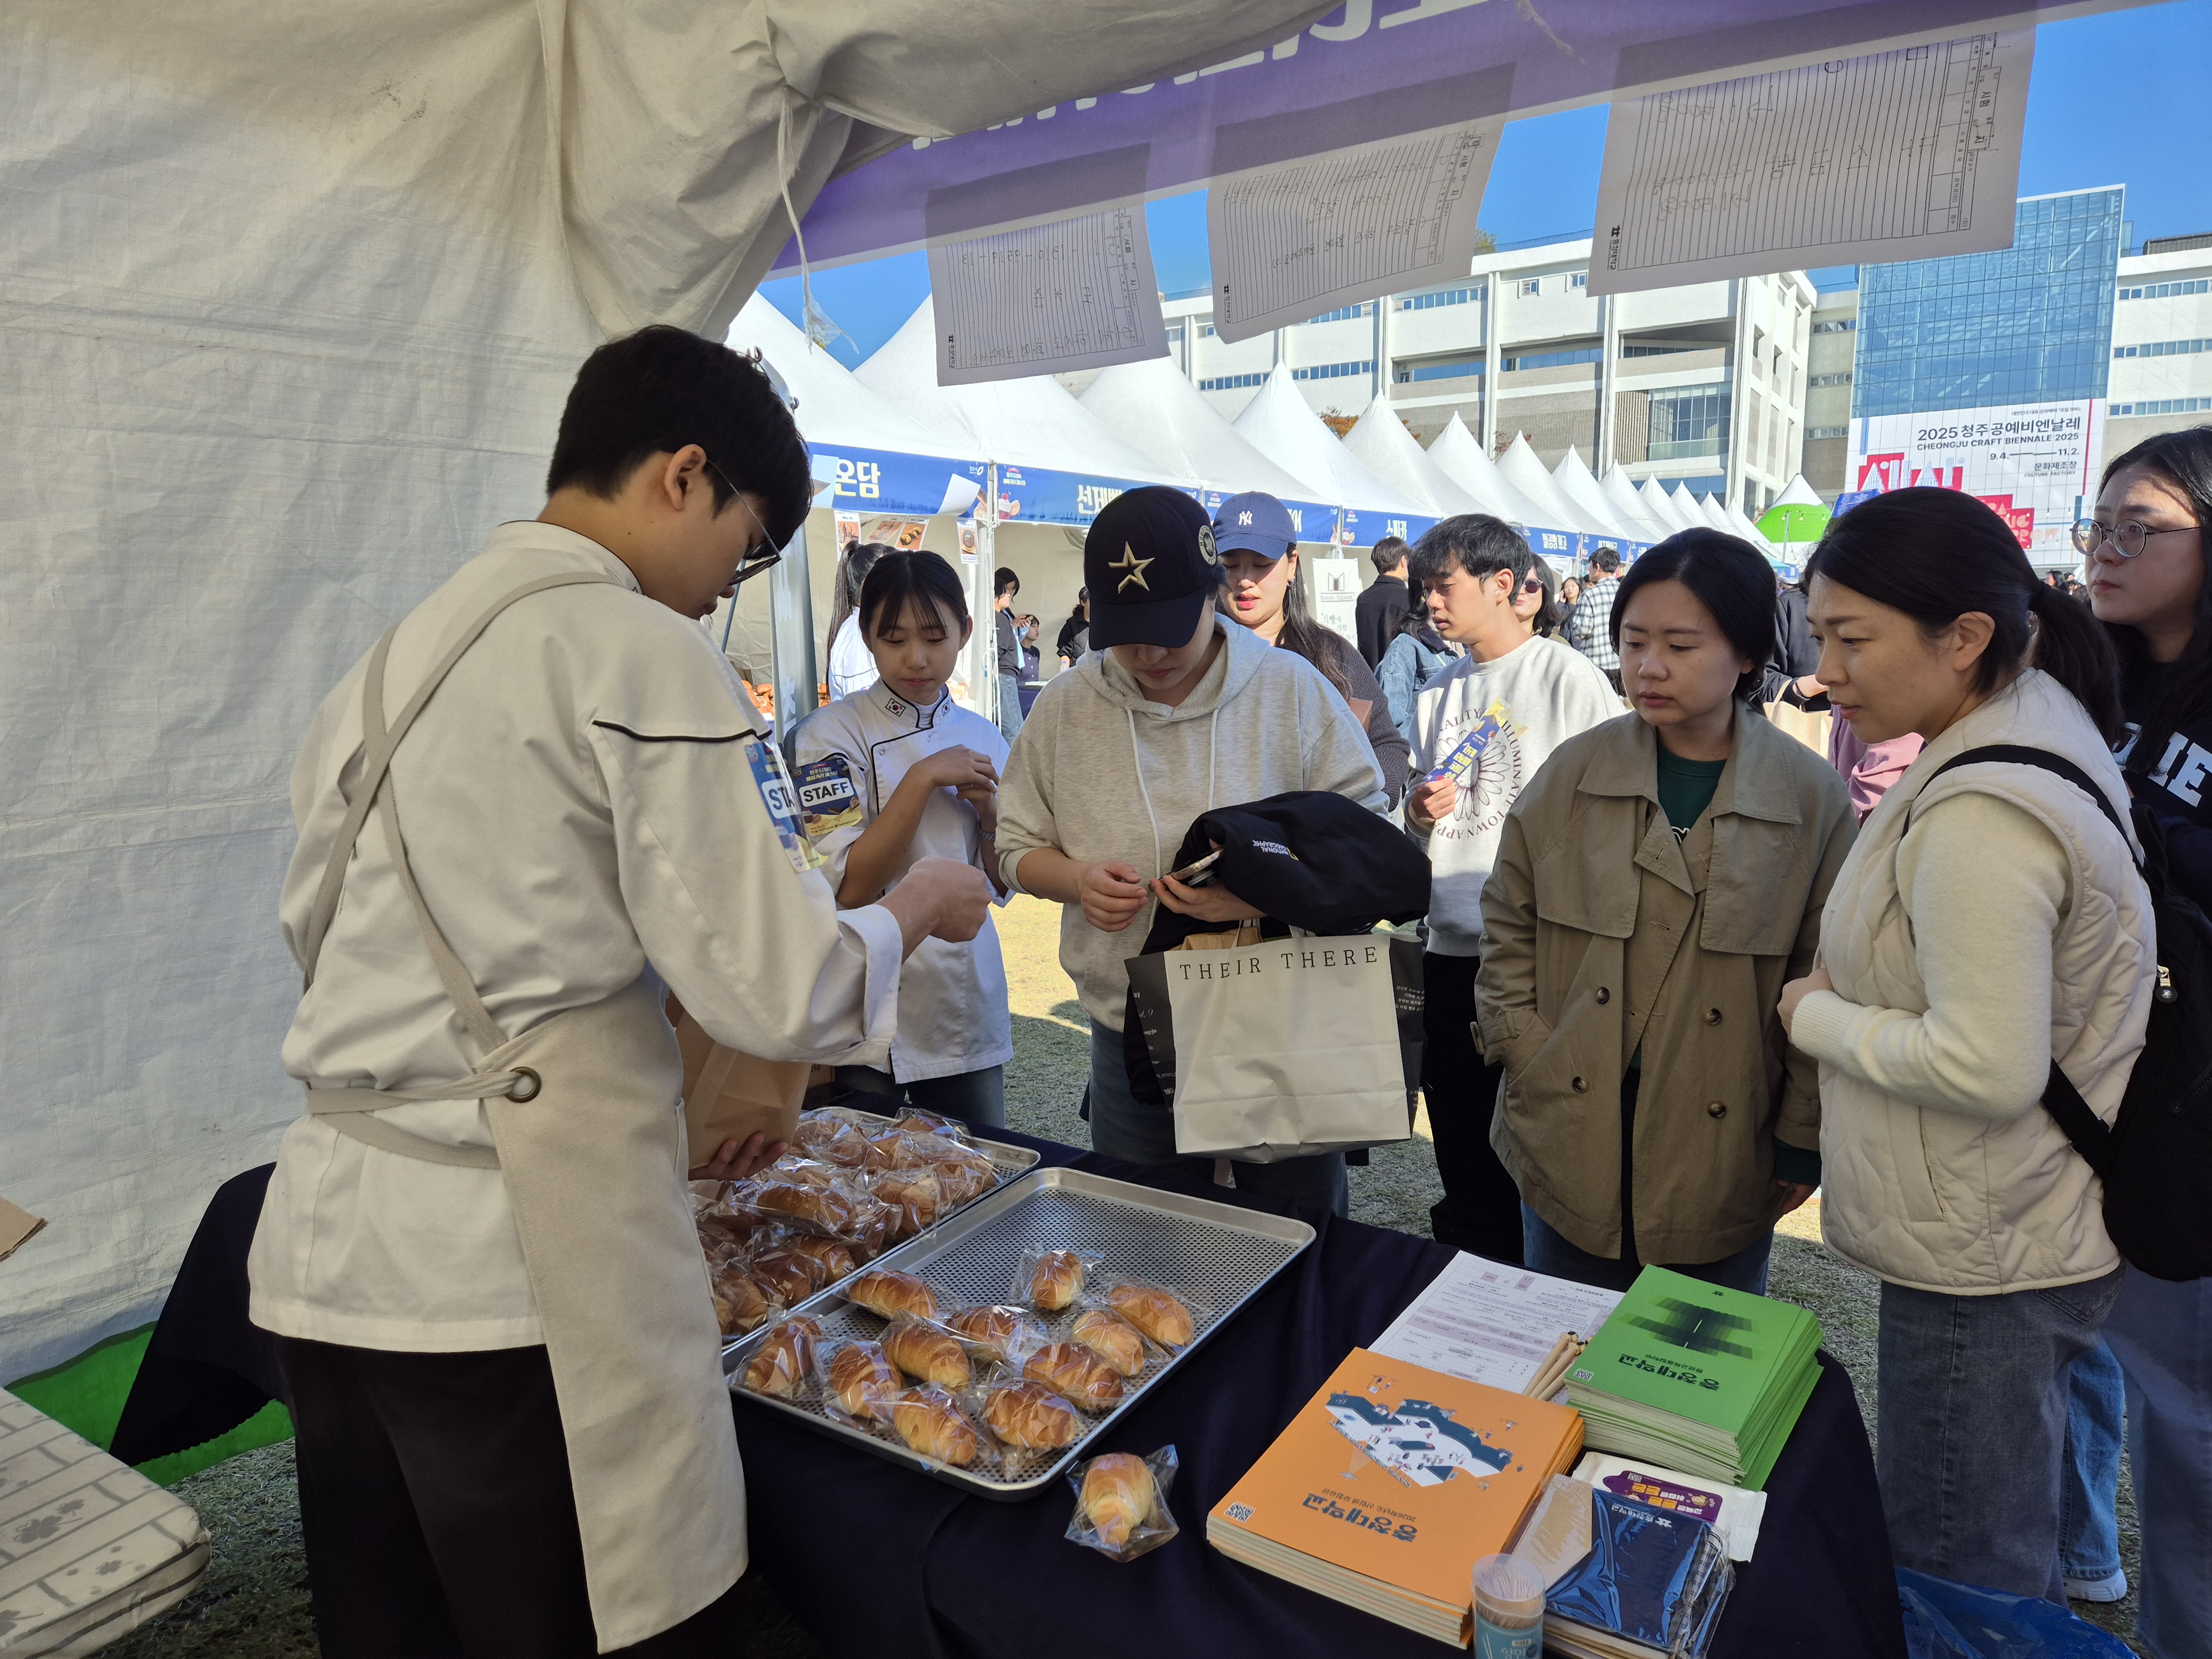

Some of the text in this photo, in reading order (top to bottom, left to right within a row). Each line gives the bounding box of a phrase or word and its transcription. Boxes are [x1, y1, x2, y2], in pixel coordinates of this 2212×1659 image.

[1918, 416, 2080, 441] 2025 청주공예비엔날레
[1917, 432, 2079, 451] CHEONGJU CRAFT BIENNALE 2025
[834, 458, 881, 498] 온담
[803, 781, 849, 802] STAFF
[1252, 839, 1287, 851] GEOGRAPHIC
[1260, 847, 1289, 855] NATIONAL
[1179, 946, 1378, 980] THEIR THERE
[1618, 1353, 1719, 1391] 충청대학교
[1352, 1498, 1375, 1509] 신입생
[1375, 1505, 1417, 1522] 2026학년도
[1611, 1504, 1653, 1522] 충청대학교
[1302, 1493, 1418, 1543] 충청대학교
